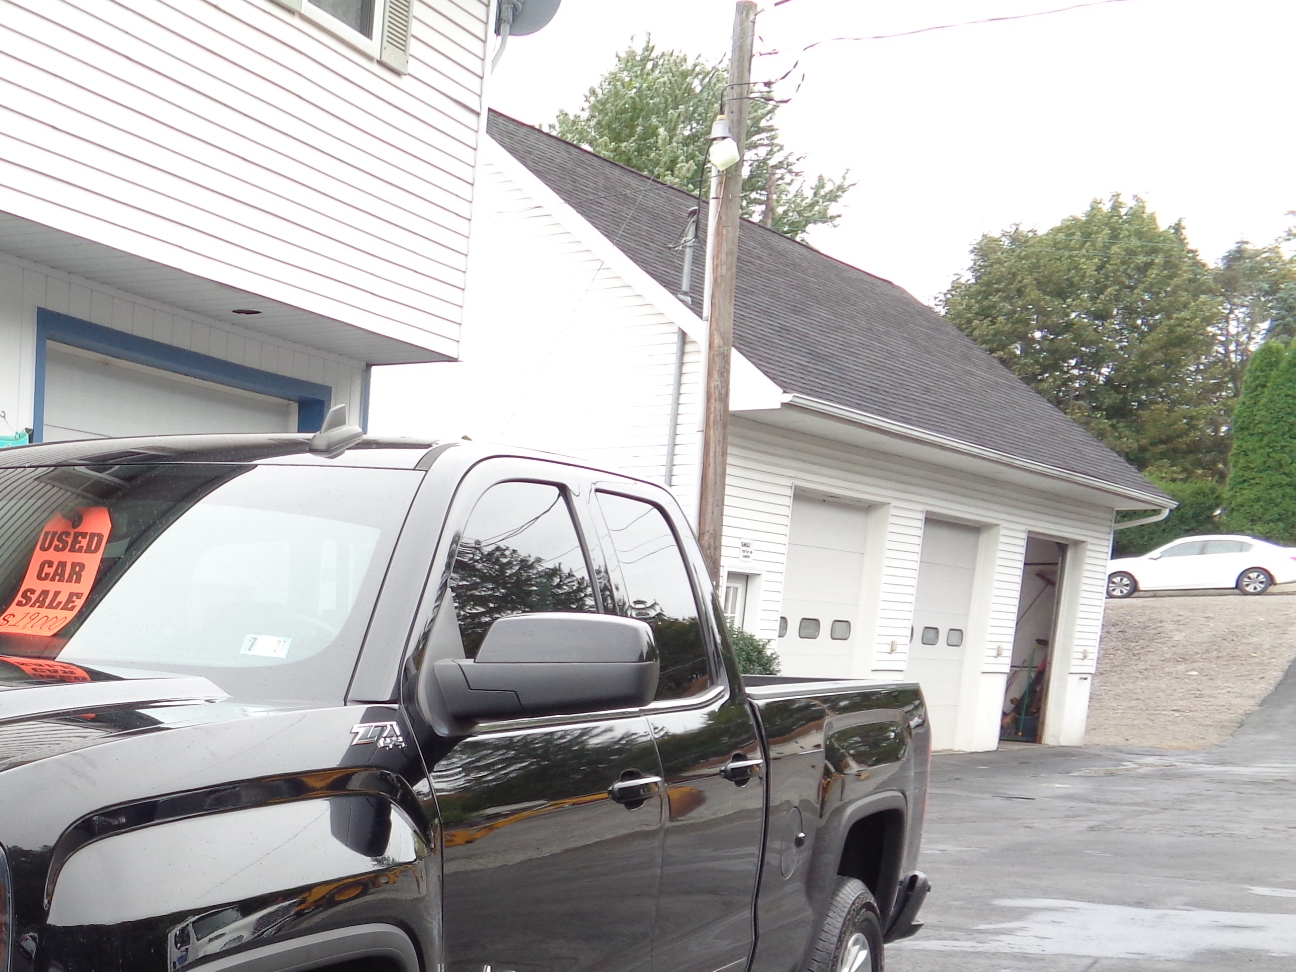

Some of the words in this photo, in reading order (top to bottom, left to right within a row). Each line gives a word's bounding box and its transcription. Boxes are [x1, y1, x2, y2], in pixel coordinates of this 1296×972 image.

[39, 530, 105, 554] USED
[36, 559, 86, 584] CAR
[16, 588, 84, 612] SALE
